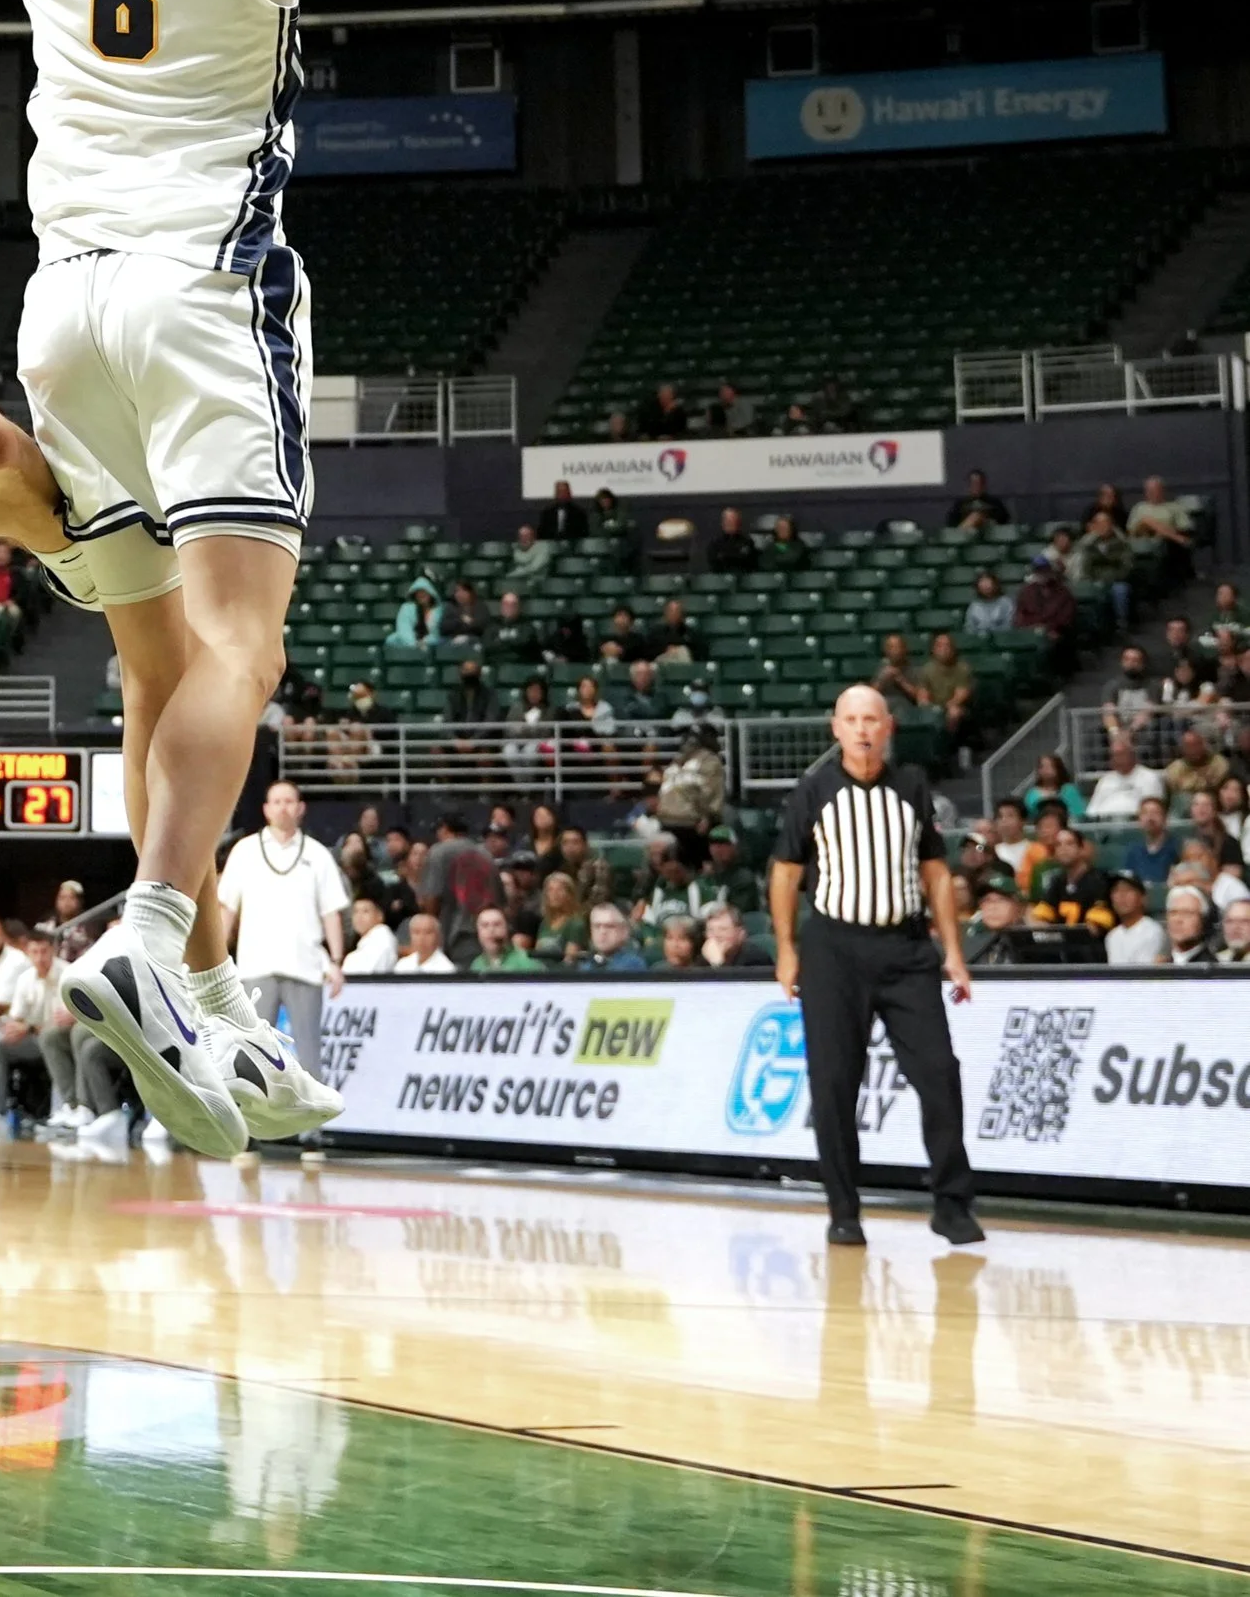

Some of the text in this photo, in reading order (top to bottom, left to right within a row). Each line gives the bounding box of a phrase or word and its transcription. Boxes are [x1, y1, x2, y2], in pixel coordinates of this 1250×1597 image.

[994, 86, 1110, 119] Energy
[562, 458, 654, 476] HAWAIIAN
[768, 451, 864, 469] HAWAIIAN
[24, 786, 70, 824] 27
[320, 1006, 378, 1037] LOHA
[580, 1015, 667, 1059] new
[320, 1040, 363, 1071] ATE
[396, 1071, 489, 1114] news
[492, 1078, 620, 1121] source
